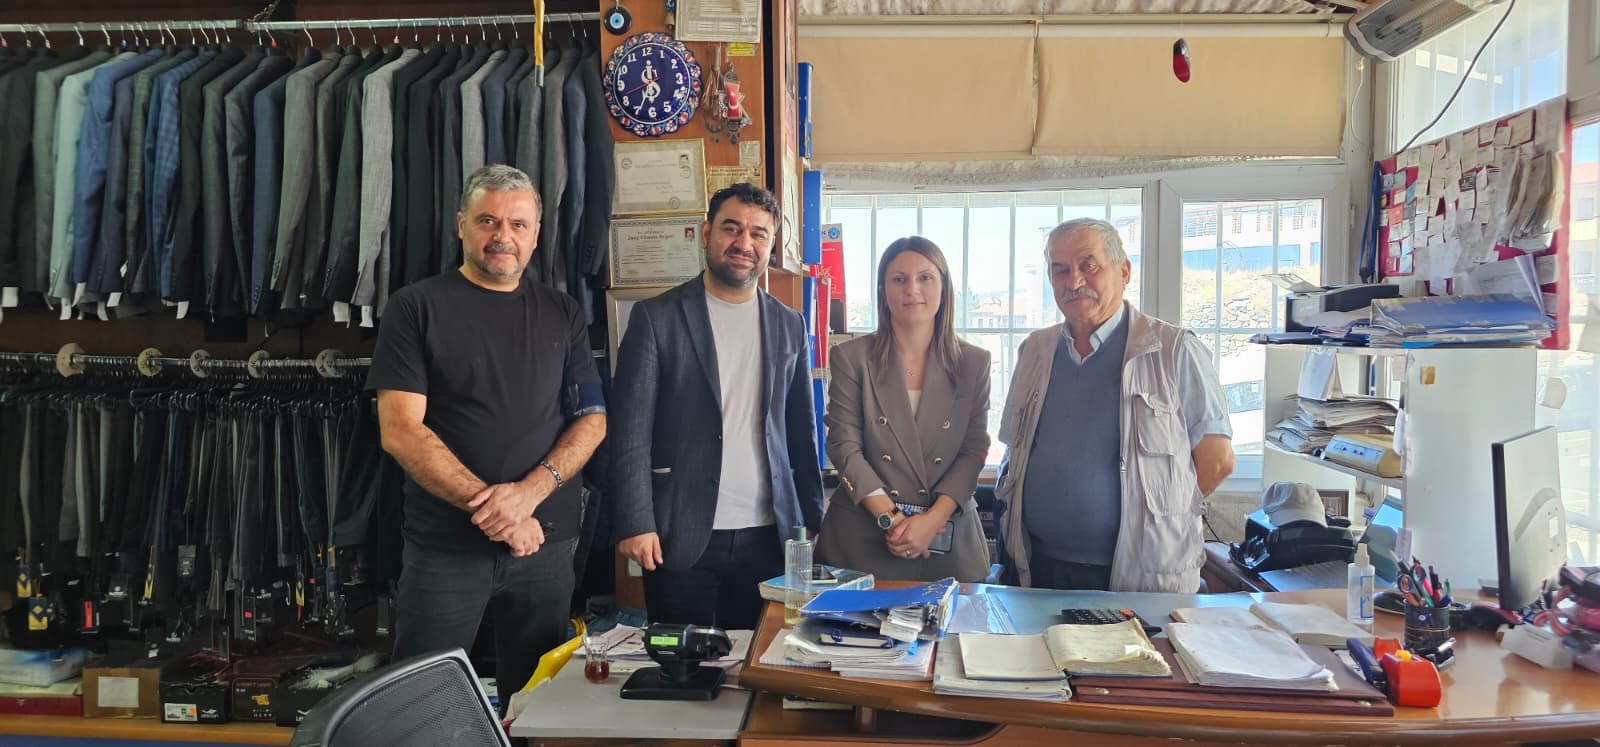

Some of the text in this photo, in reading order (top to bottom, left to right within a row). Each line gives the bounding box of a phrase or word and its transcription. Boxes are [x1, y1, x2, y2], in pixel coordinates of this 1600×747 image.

[642, 47, 652, 56] 12
[660, 50, 665, 58] 1
[627, 53, 637, 62] 11
[671, 59, 678, 69] 2
[618, 65, 628, 75] 10
[676, 73, 683, 84] 3
[617, 80, 625, 91] 9
[622, 96, 630, 106] 8
[633, 105, 641, 115] 7
[663, 101, 671, 112] 5
[648, 107, 657, 118] 6
